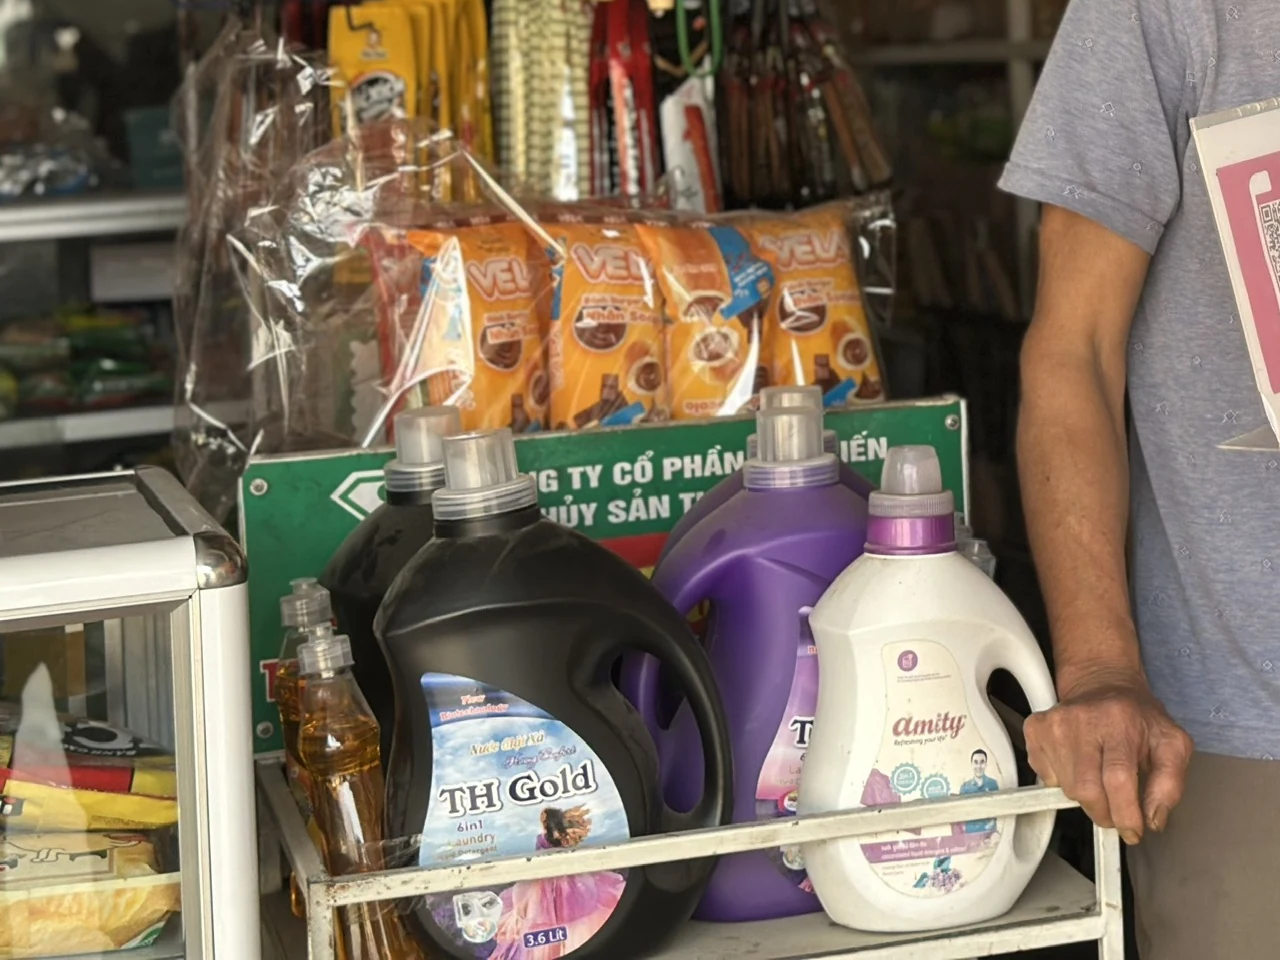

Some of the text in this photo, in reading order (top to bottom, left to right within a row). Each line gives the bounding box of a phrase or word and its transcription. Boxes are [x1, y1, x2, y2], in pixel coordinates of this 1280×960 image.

[468, 257, 536, 301] VEL
[571, 246, 653, 281] VEL
[570, 465, 603, 491] TY
[612, 451, 654, 485] CỔ
[662, 444, 746, 480] PHẦN
[842, 430, 889, 463] IẾN
[540, 496, 599, 530] HỦY
[607, 489, 671, 523] SẢN
[892, 711, 966, 740] amity
[893, 735, 923, 746] Refreshing
[924, 735, 937, 745] your
[439, 760, 598, 817] TH Gold
[456, 819, 483, 833] 6in1
[526, 932, 546, 947] 3.6
